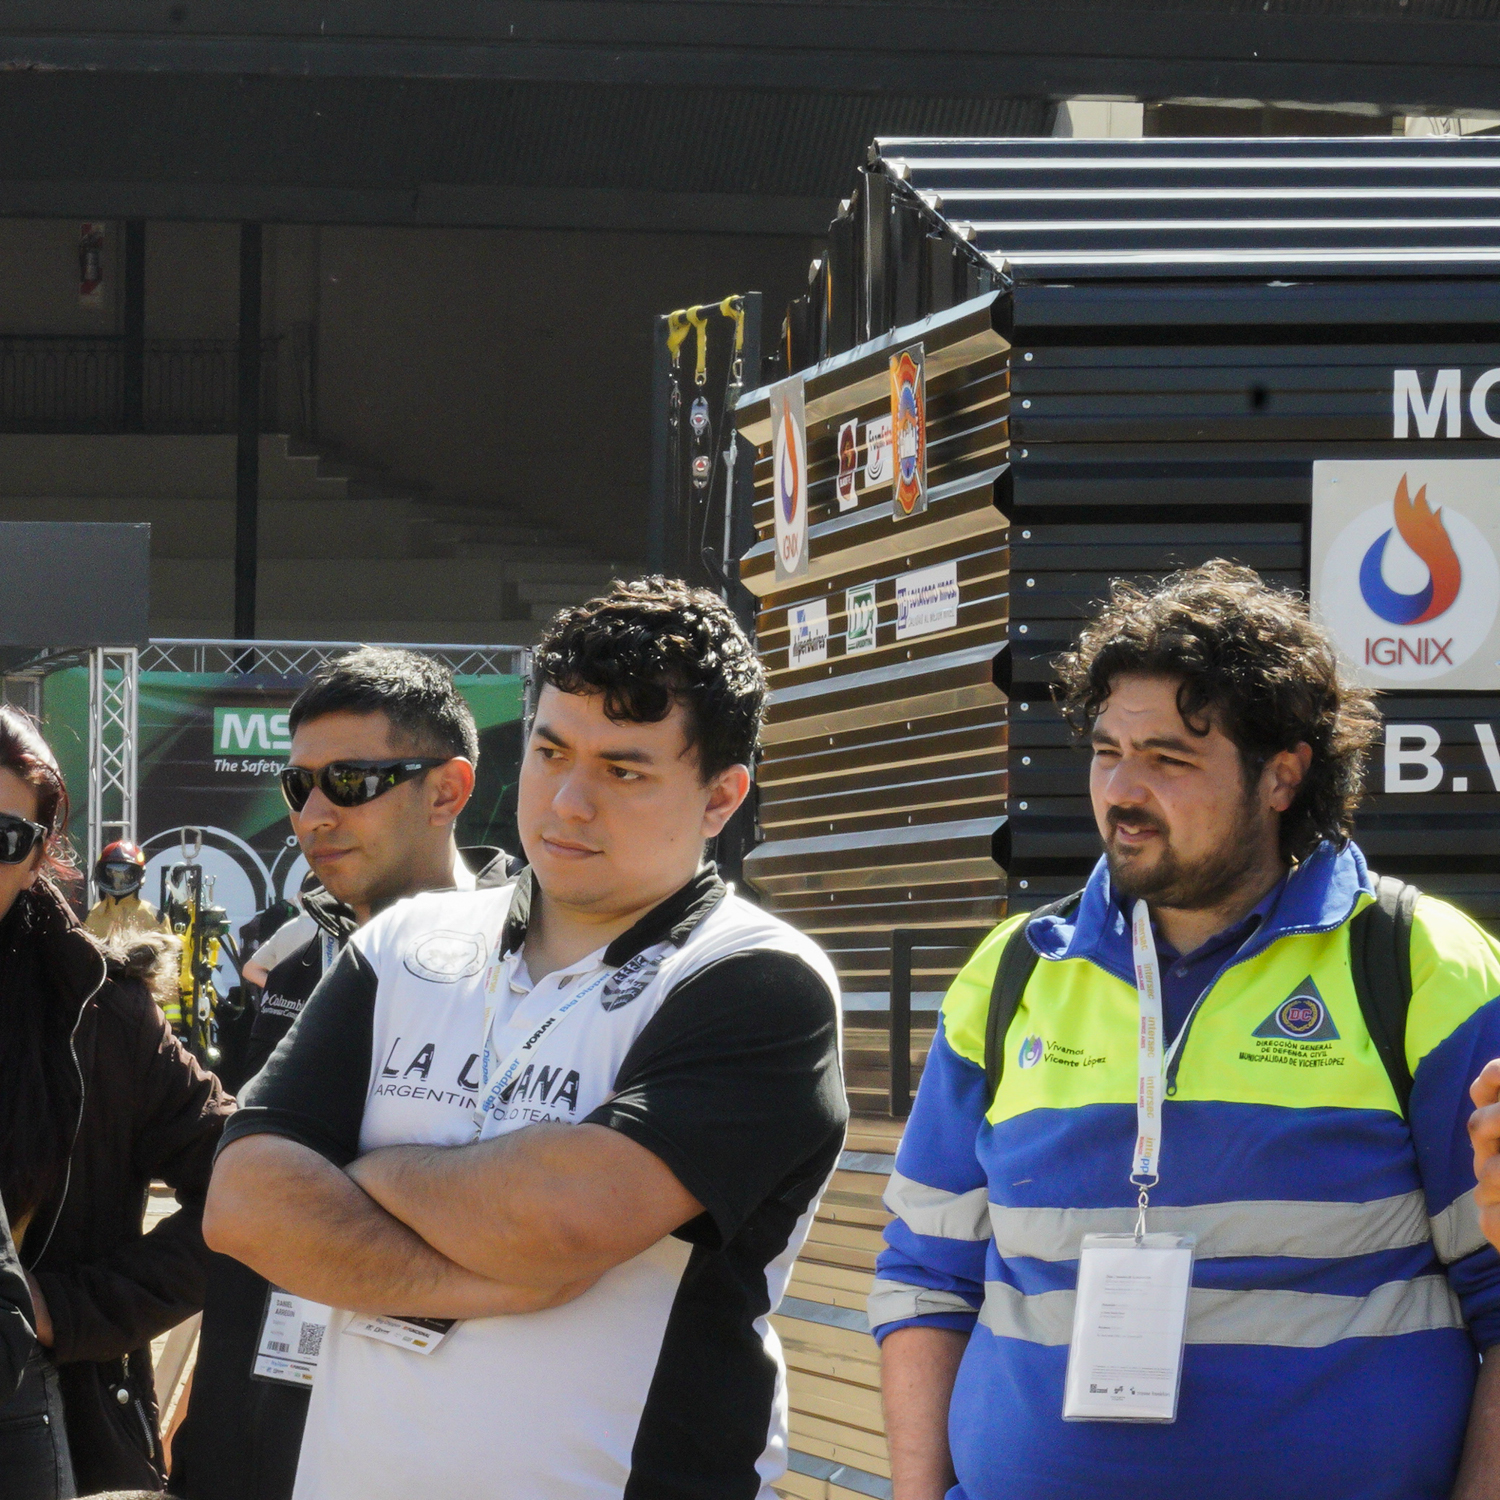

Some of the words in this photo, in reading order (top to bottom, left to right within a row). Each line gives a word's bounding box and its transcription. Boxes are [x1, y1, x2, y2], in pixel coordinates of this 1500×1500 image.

[1365, 637, 1453, 666] IGNIX
[220, 713, 292, 750] MS
[214, 759, 238, 773] The
[241, 759, 285, 777] Safety
[559, 996, 578, 1013] Big
[575, 971, 611, 1000] Dipper
[1143, 962, 1155, 1000] intersec
[268, 993, 306, 1012] Columbi
[1288, 1007, 1312, 1021] DC
[523, 1017, 556, 1051] VORAN
[1147, 1016, 1158, 1058] intersec
[1256, 1040, 1298, 1050] DIRECCIÓN
[1299, 1043, 1333, 1051] GENERAL
[382, 1036, 436, 1083] LA
[1046, 1040, 1084, 1055] Vivamos
[1239, 1051, 1289, 1064] MUNICIPALIDAD
[1289, 1057, 1297, 1067] DE
[1299, 1058, 1321, 1068] VICENTE
[1272, 1047, 1308, 1058] DEFENSA
[1310, 1050, 1328, 1058] CIVIL
[1044, 1053, 1080, 1068] Vicente
[1083, 1055, 1107, 1069] López
[491, 1057, 520, 1094] Dipper
[374, 1083, 478, 1109] ARGENTIN
[1145, 1076, 1156, 1119] intersec
[522, 1108, 573, 1125] TEA
[1145, 1136, 1157, 1158] inte
